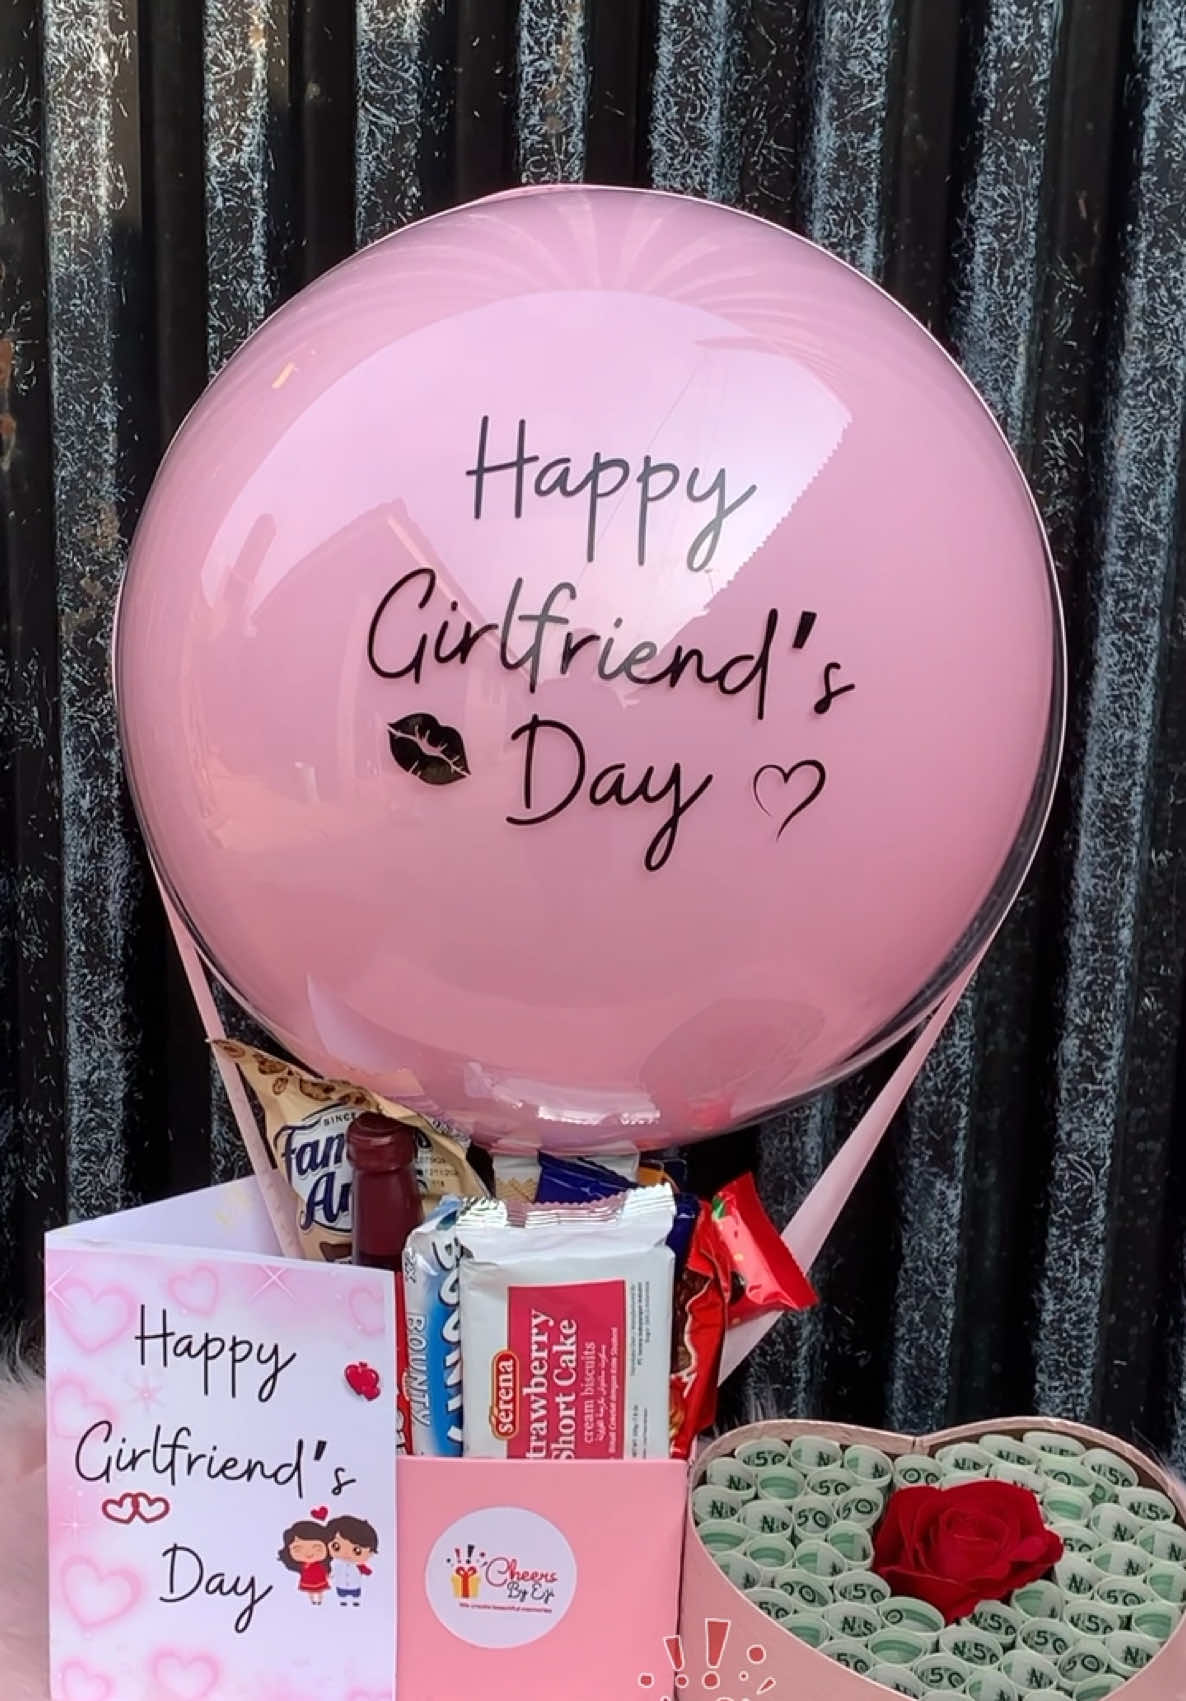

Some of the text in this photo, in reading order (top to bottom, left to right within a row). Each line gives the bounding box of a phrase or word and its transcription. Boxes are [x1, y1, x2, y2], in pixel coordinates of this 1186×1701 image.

[466, 416, 757, 572] Happy
[367, 568, 855, 720] Girlfriend's
[506, 714, 713, 871] Day
[134, 1304, 296, 1402] Happy
[407, 1312, 431, 1427] BOUNTY
[522, 1309, 555, 1459] trawberry
[551, 1319, 577, 1387] Cake
[581, 1341, 596, 1443] cream biscuits
[75, 1420, 357, 1499] Girlfriend's
[159, 1543, 273, 1634] Day
[485, 1556, 559, 1588] Cheers
